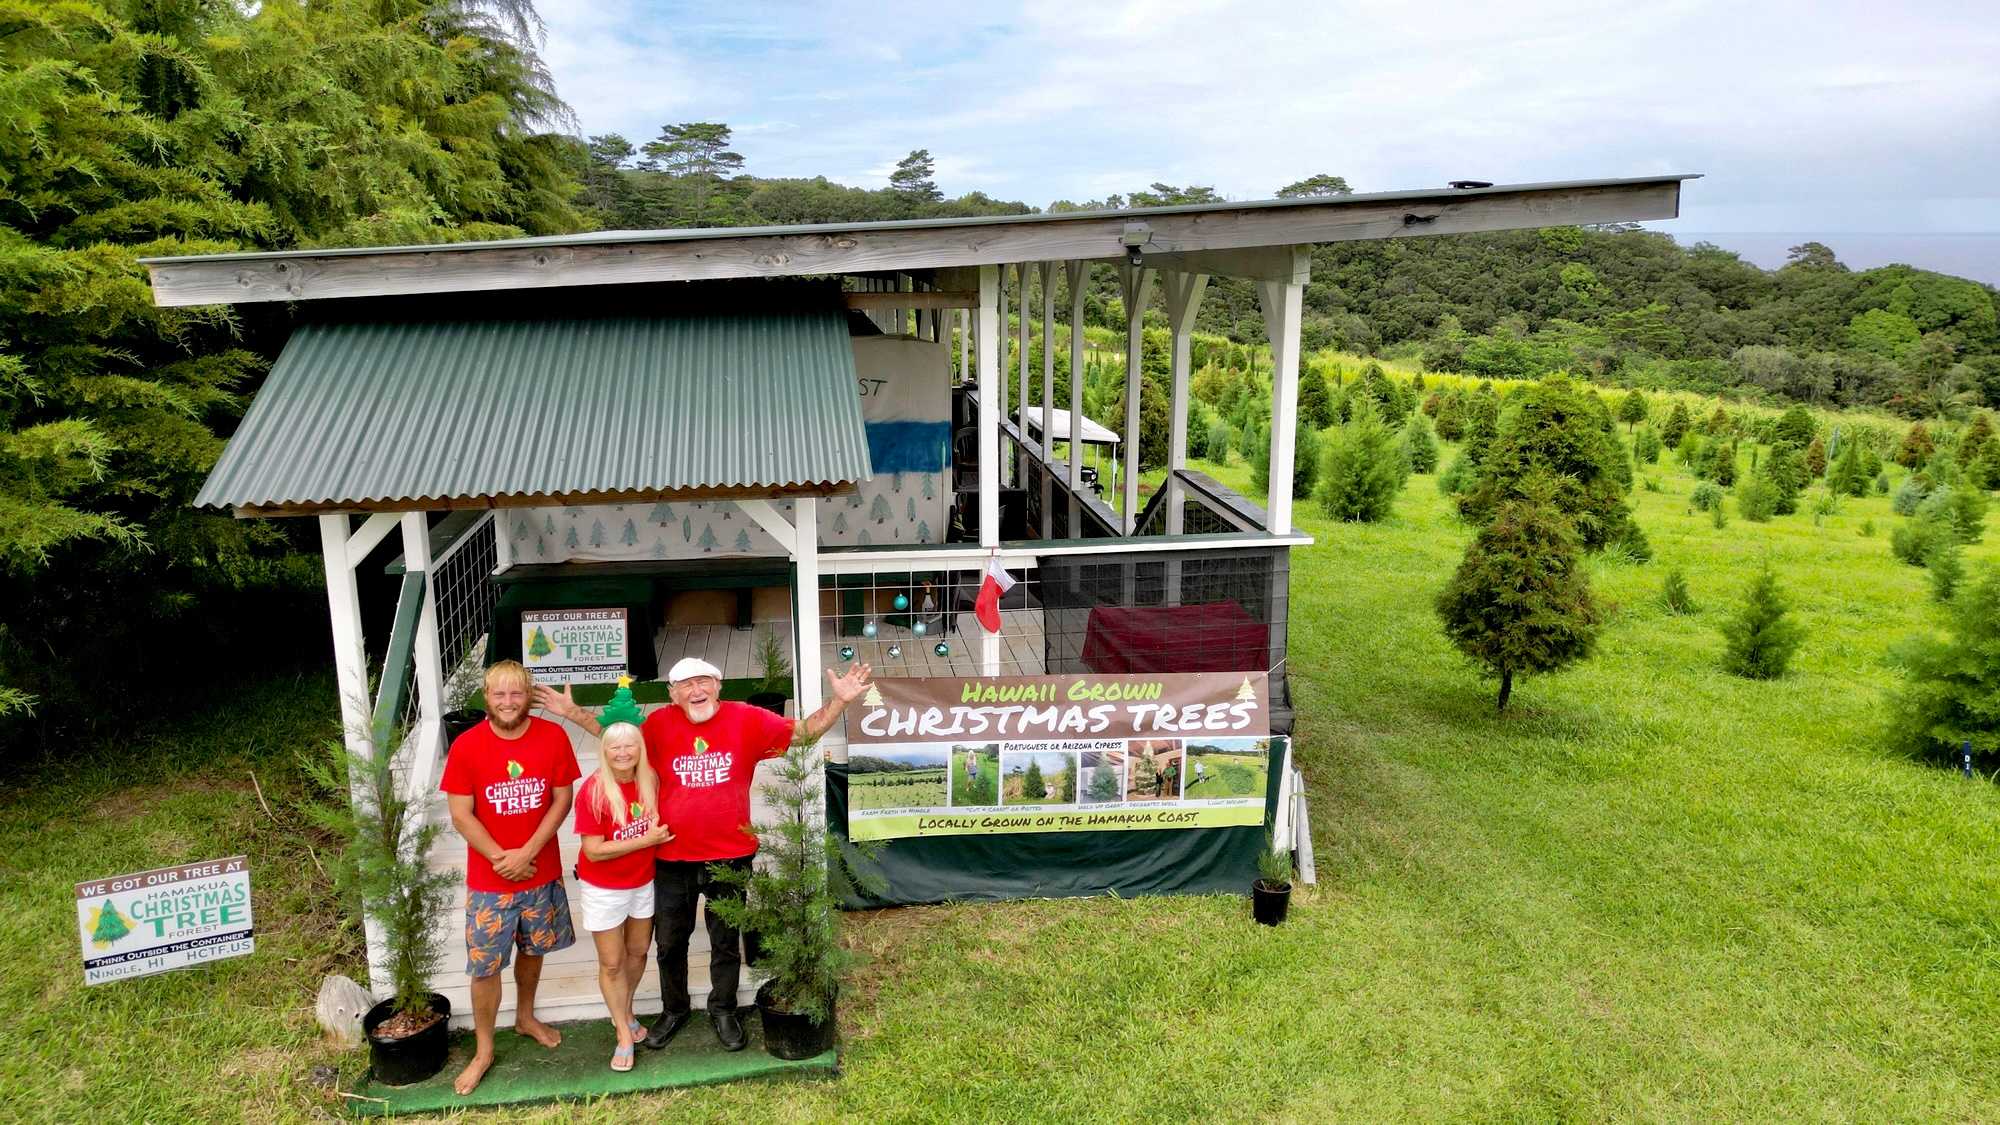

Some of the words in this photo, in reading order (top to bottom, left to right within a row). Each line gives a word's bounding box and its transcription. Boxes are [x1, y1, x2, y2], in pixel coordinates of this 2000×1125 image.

[857, 376, 888, 397] ST
[525, 613, 539, 621] WE
[542, 613, 561, 621] GOT
[610, 611, 622, 619] AT
[552, 627, 623, 644] CHRISTMAS
[560, 642, 623, 659] TREE
[574, 655, 606, 663] FOREST
[961, 681, 1057, 703] HAWAII
[1067, 679, 1163, 701] GROWN
[860, 703, 1117, 737] CHRISTMAS
[1127, 701, 1258, 732] TREES
[1003, 742, 1048, 751] PORTUGUESE
[1062, 742, 1092, 750] ARIZONA
[1094, 741, 1123, 749] CYPRESS
[672, 752, 732, 772] CHRISTMAS
[675, 767, 730, 785] TREE
[485, 778, 546, 799] CHRISTMAS
[489, 792, 543, 814] TREE
[502, 808, 528, 816] FORES
[613, 821, 648, 840] CHRIST
[918, 817, 977, 830] LOCALLY
[981, 816, 1031, 827] GROWN
[1036, 817, 1054, 826] ON
[1059, 816, 1083, 826] THE
[1087, 813, 1152, 825] HAMAKUA
[1157, 811, 1200, 823] COAST
[82, 883, 106, 897] WE
[111, 877, 142, 891] GOT
[147, 871, 178, 884] OUR
[183, 865, 221, 879] TREE
[225, 860, 243, 873] AT
[147, 880, 230, 900] HAMAKUA
[130, 882, 246, 920] CHRISTMAS
[143, 903, 247, 938] TREE
[168, 924, 219, 939] FOREST
[89, 955, 125, 967] "THINK
[127, 946, 169, 960] OUTSIDE
[170, 943, 189, 952] THE
[190, 931, 249, 948] CONTAINER"
[148, 957, 165, 969] HI
[186, 941, 251, 960] HCTF.US
